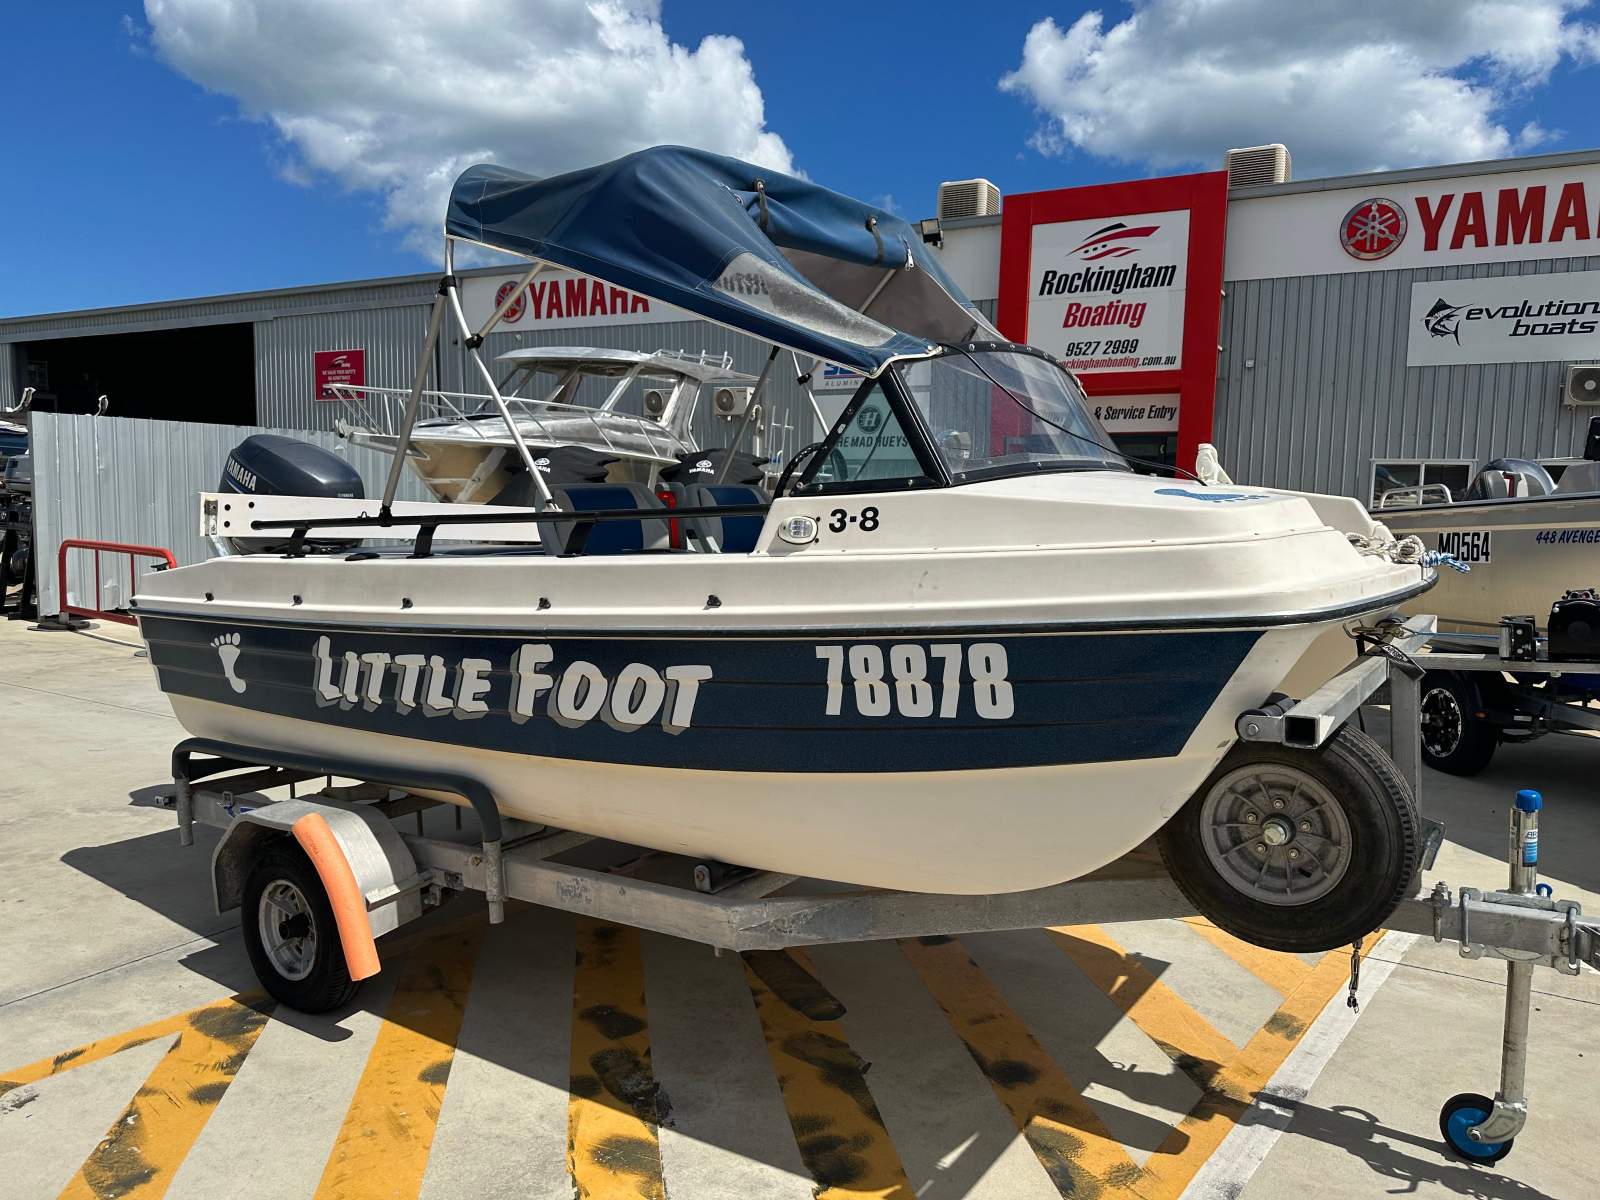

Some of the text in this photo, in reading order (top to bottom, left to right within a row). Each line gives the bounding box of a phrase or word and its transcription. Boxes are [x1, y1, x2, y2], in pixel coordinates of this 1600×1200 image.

[1415, 182, 1600, 252] YAMA
[1039, 263, 1177, 296] Rockingham
[1062, 300, 1147, 329] Boating
[1465, 300, 1600, 321] evolution
[1509, 318, 1599, 337] boats
[1066, 339, 1139, 357] 9527 2999
[1058, 355, 1177, 370] ockinghamboating.com.au
[824, 379, 861, 387] ALUMIN
[1104, 405, 1145, 421] Service
[1147, 404, 1177, 421] Entry
[850, 436, 873, 448] MAD
[226, 457, 257, 491] YAMAHA
[828, 506, 880, 533] 3-8
[1536, 529, 1600, 544] 448 AVENGE
[815, 642, 1015, 720] 78878
